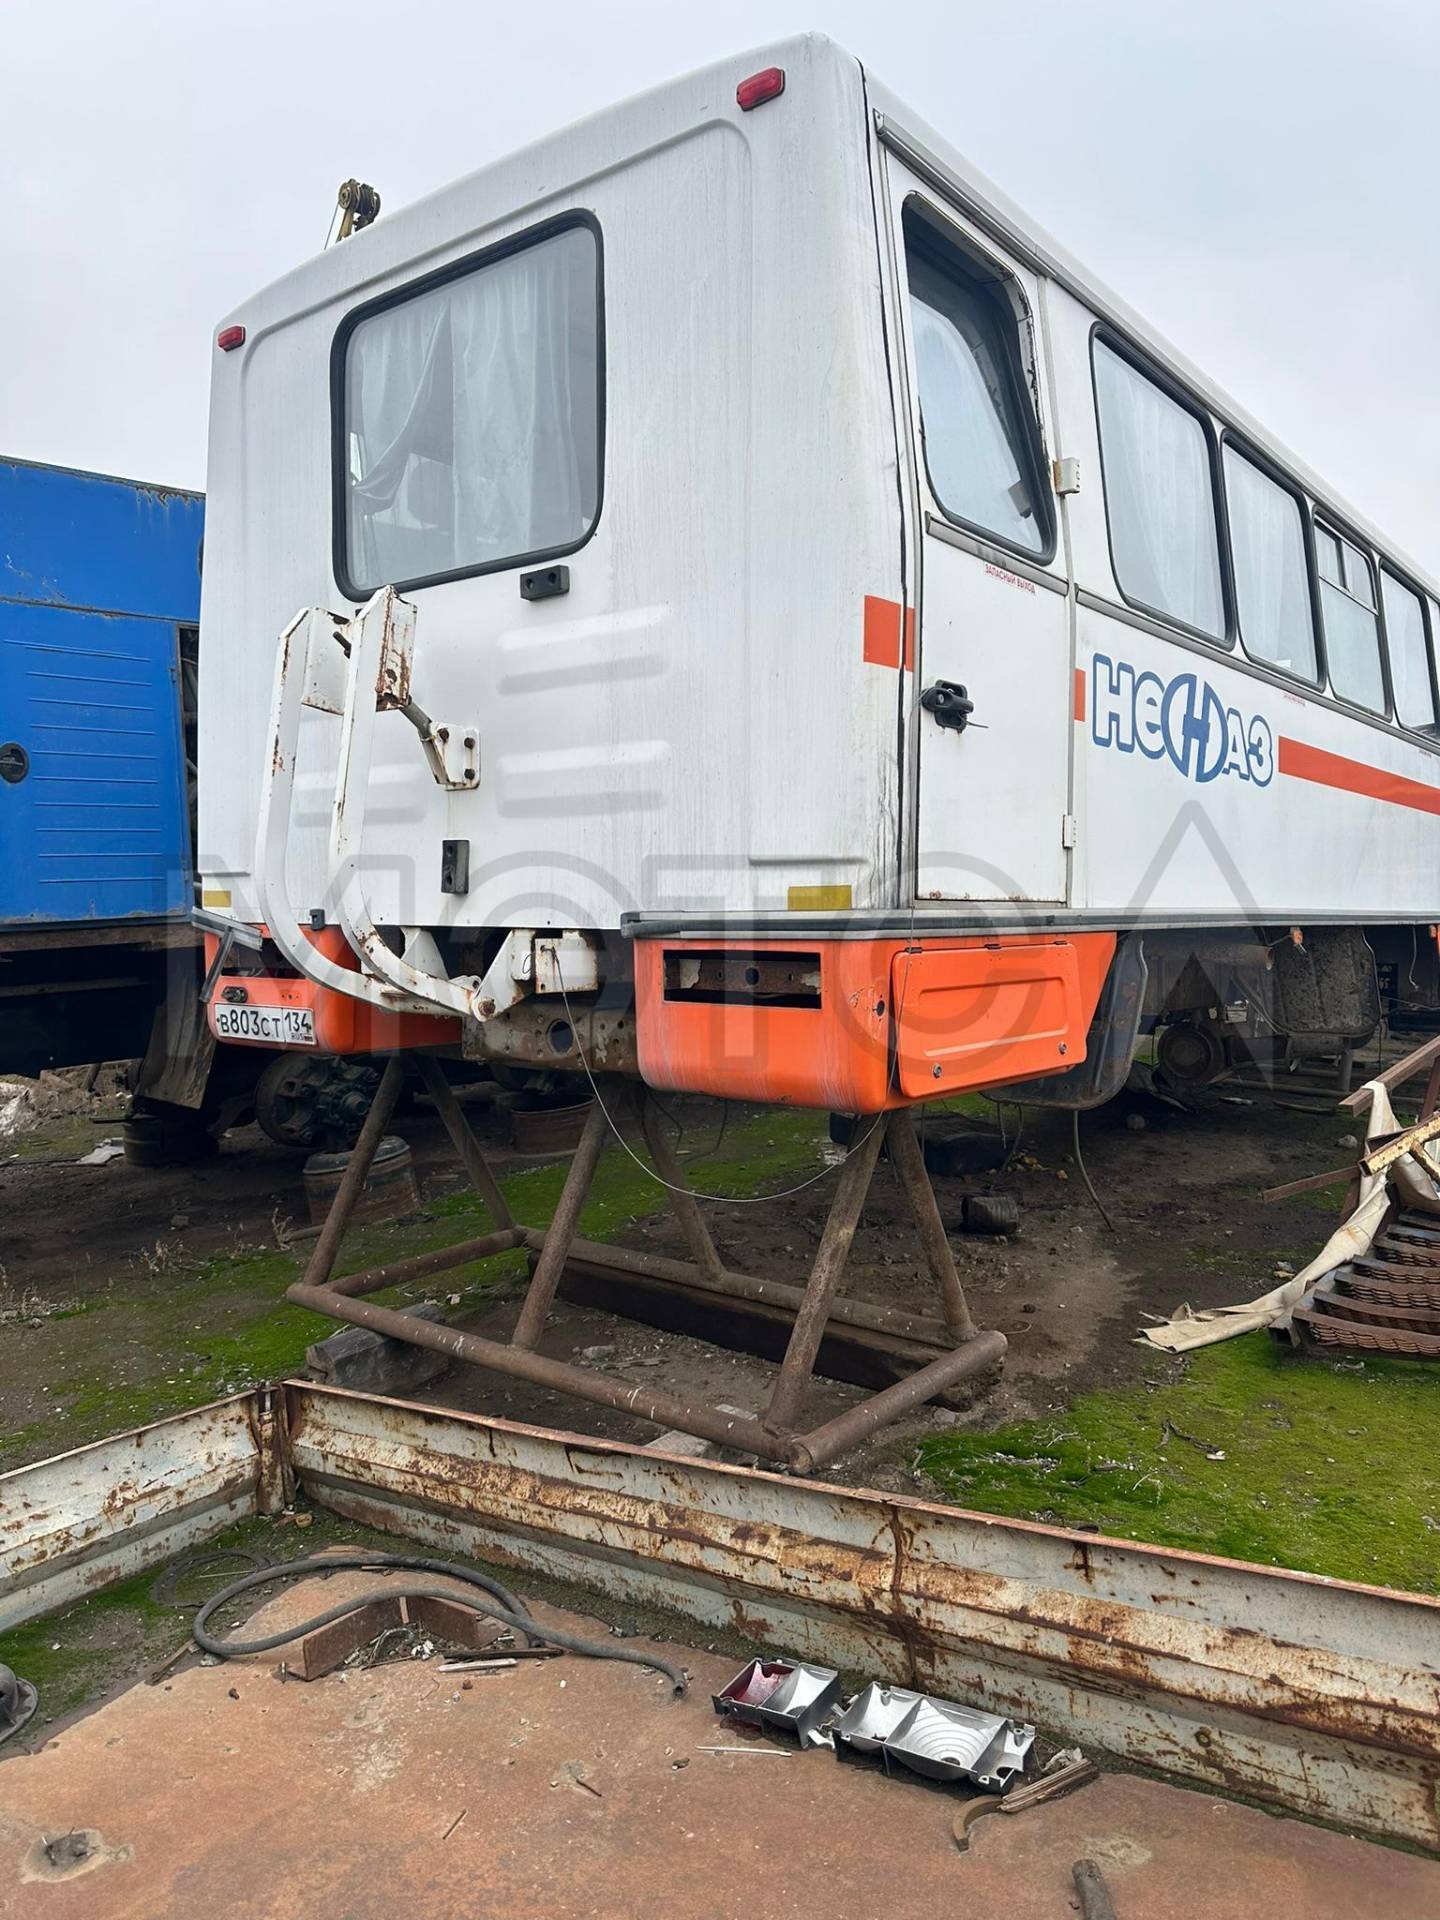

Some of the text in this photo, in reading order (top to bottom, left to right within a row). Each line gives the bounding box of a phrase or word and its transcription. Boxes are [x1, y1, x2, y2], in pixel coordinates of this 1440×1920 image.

[985, 563, 1036, 594] ЗАПАСНЫЙ ВЫХОД
[285, 1012, 310, 1033] 134
